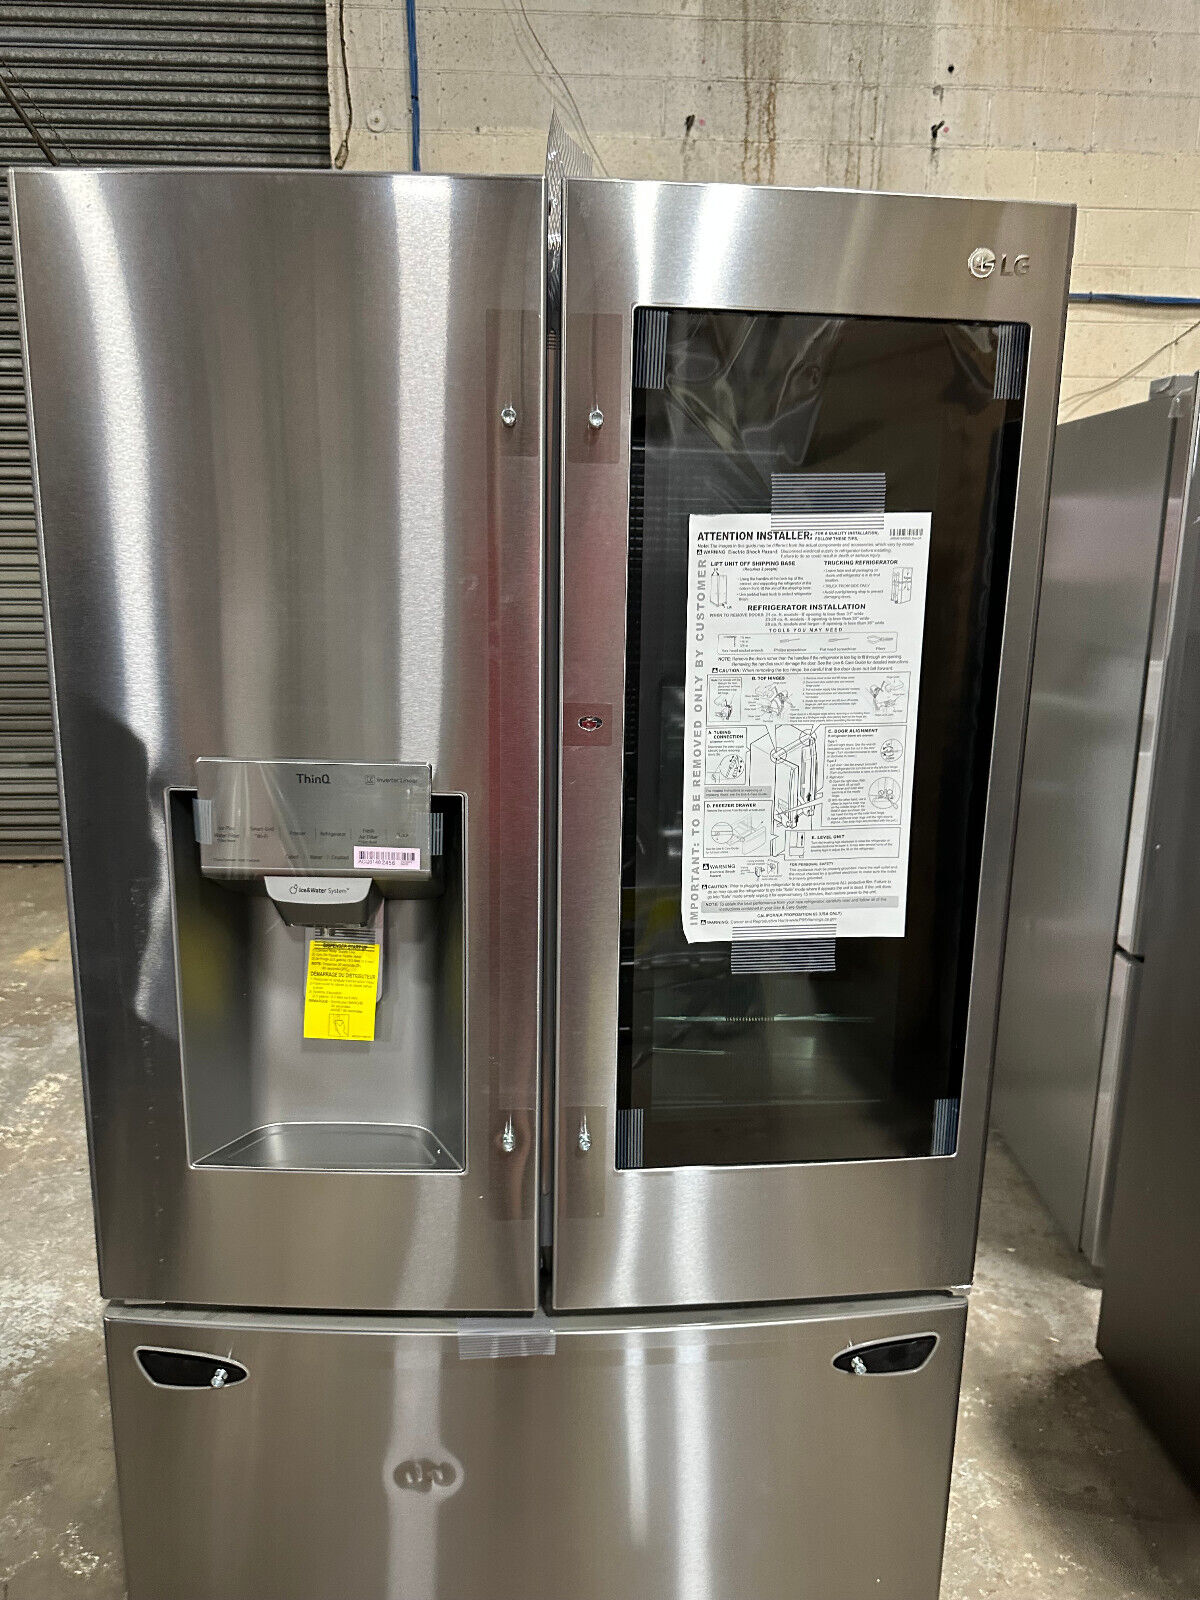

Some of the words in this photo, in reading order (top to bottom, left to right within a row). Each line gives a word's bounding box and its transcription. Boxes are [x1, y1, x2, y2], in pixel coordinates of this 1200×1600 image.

[1000, 253, 1030, 277] LG
[697, 532, 754, 541] ATTENTION
[756, 531, 813, 540] INSTALLER:
[696, 559, 707, 641] CUSTOMER
[695, 650, 704, 667] BY
[694, 675, 703, 712] ONLY
[693, 721, 702, 787] REMOVED
[296, 773, 331, 785] ThinQ
[692, 795, 700, 811] BE
[691, 818, 700, 835] TO
[298, 886, 327, 895] Ice&Water
[690, 843, 700, 926] IMPORTANT:
